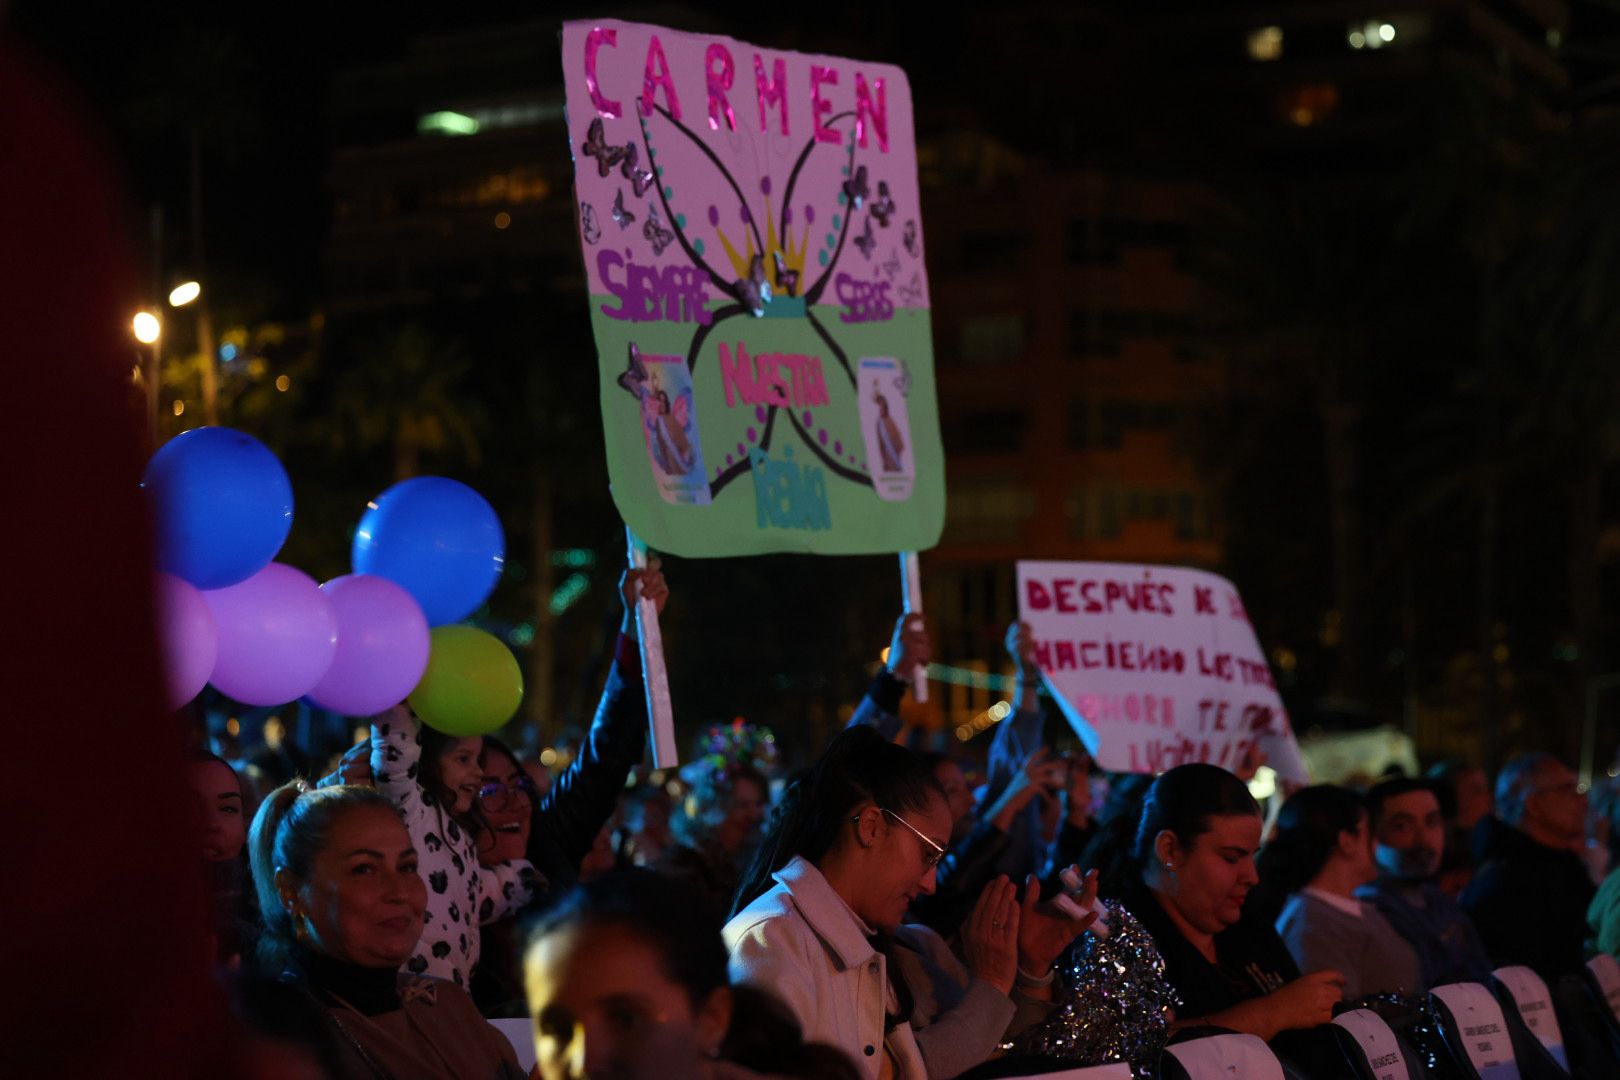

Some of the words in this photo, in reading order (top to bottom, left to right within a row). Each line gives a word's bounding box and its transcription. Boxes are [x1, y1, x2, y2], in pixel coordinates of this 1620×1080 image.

[584, 28, 888, 152] CARMEN
[719, 340, 830, 408] NUESTRA
[1027, 571, 1175, 615] DESPUÉS
